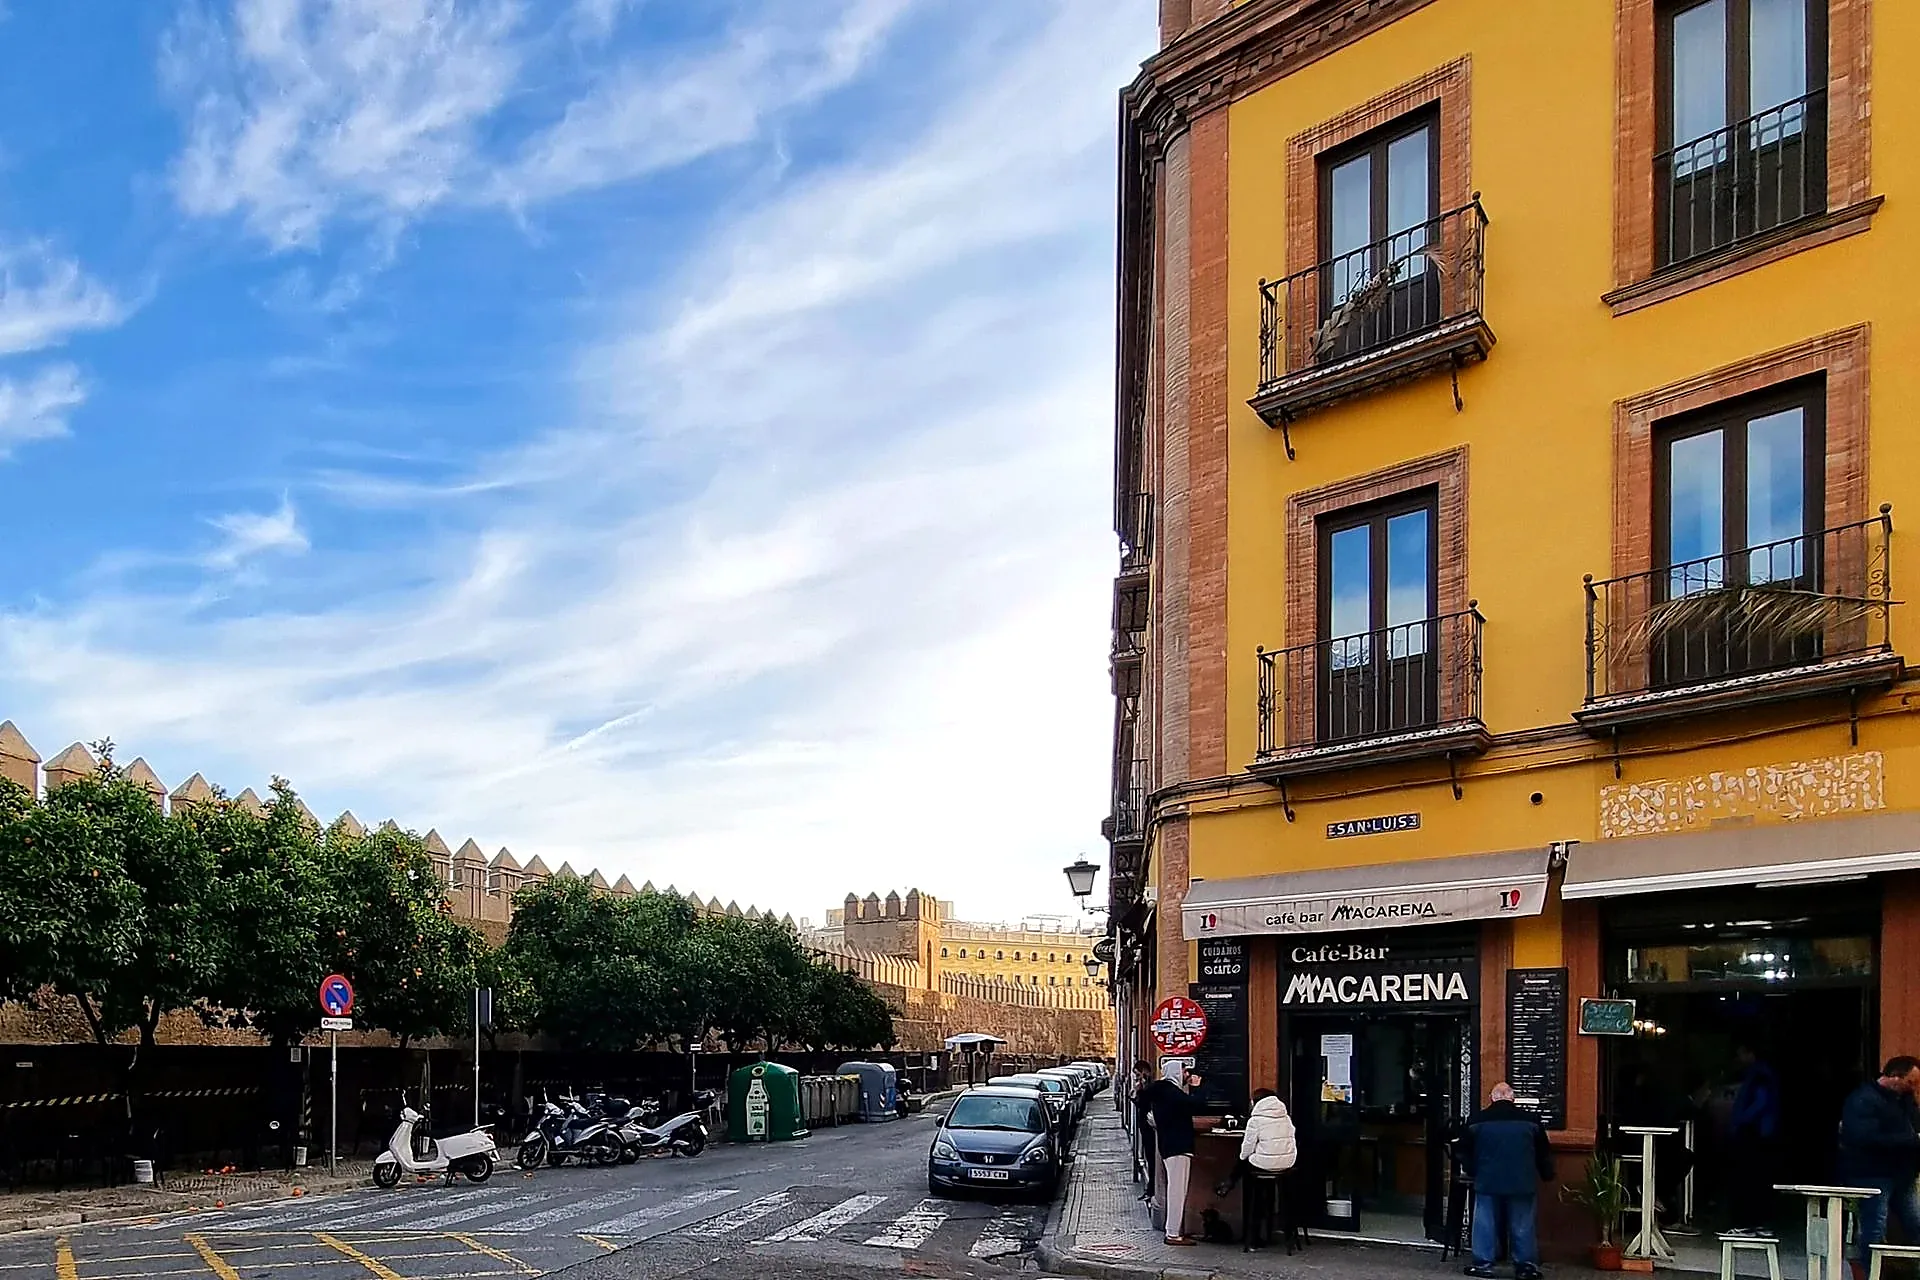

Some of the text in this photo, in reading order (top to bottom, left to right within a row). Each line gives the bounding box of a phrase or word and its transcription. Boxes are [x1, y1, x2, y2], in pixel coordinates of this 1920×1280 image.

[1336, 815, 1407, 835] SAN LUIS
[1265, 902, 1436, 926] café bar MACARENA
[1202, 945, 1242, 957] CUIDAMOS
[1282, 972, 1469, 1004] MACARENA
